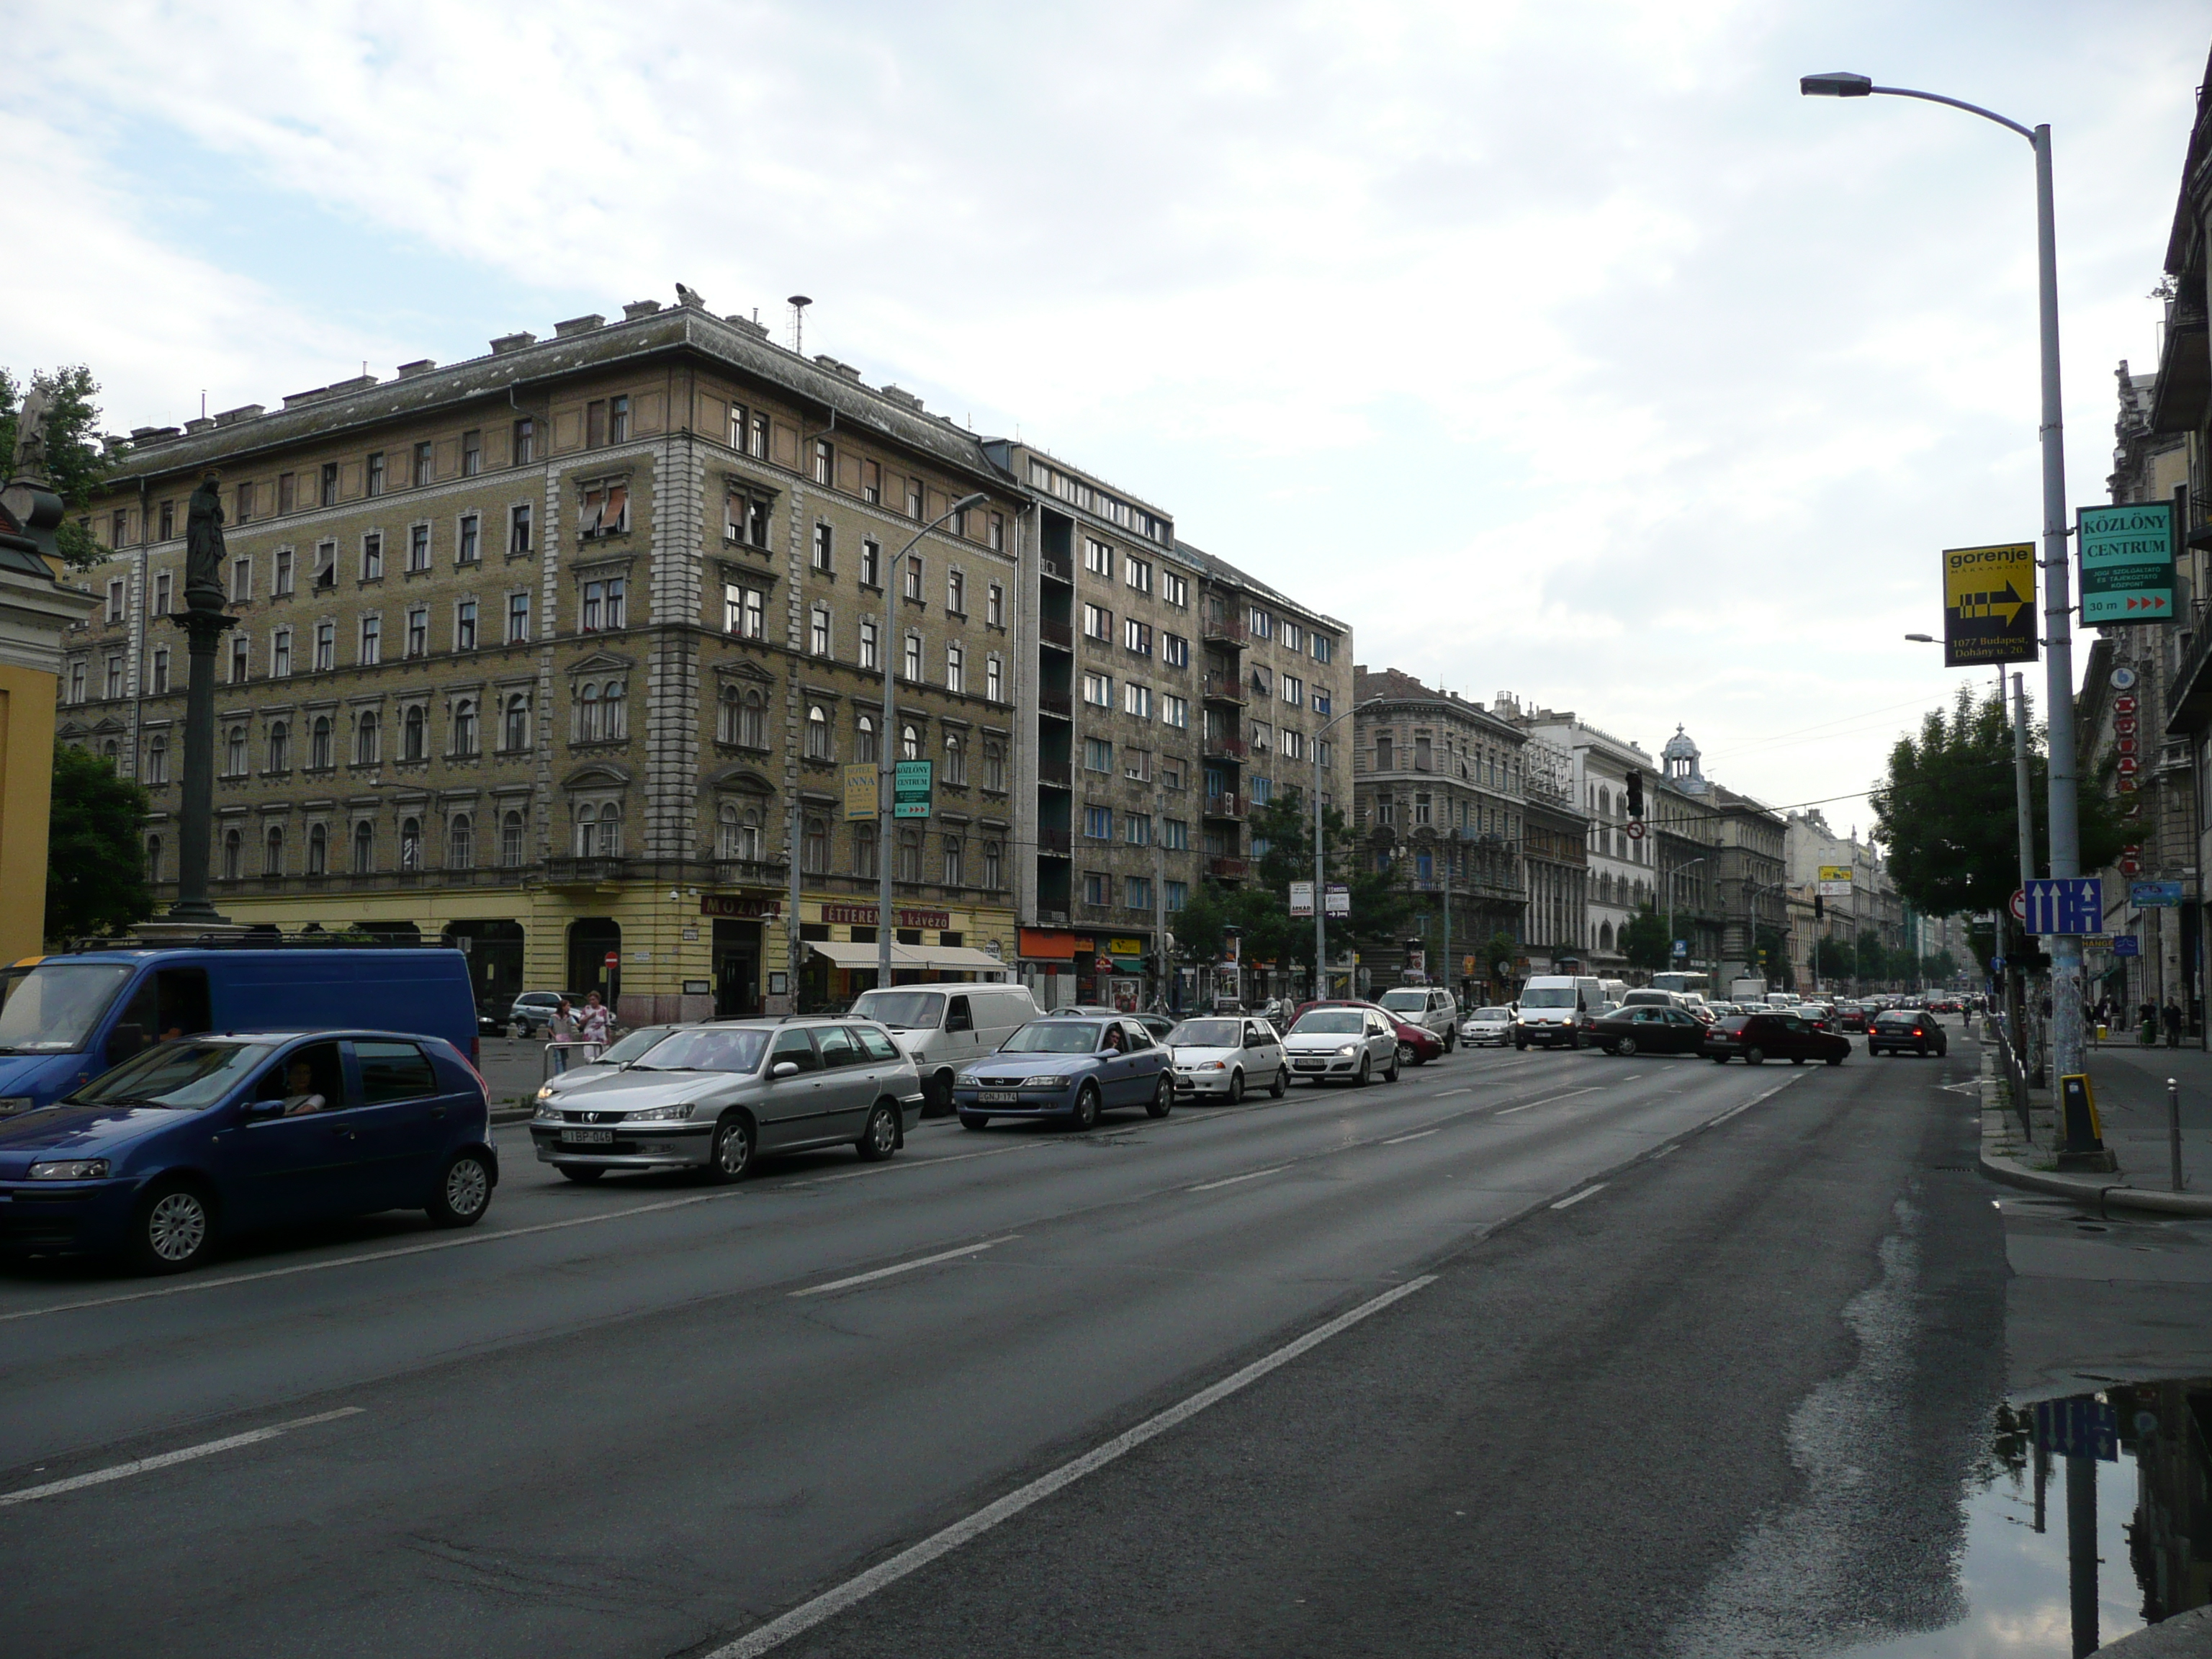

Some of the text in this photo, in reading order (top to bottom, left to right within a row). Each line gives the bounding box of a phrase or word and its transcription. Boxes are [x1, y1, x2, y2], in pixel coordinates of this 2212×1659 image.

[2084, 512, 2167, 534] KÖZLÖNY
[2087, 540, 2165, 558] CENTRUM
[1950, 548, 2028, 569] gorenje
[2090, 602, 2103, 611] 30
[1953, 636, 2029, 647] 1077 Budapest,
[1955, 647, 1994, 658] Dohány
[2010, 646, 2026, 655] 20.
[897, 765, 929, 774] KÖZLÖNY
[846, 776, 876, 787] ANNA
[706, 898, 777, 916] MOZAIK
[907, 912, 948, 928] kávézó
[984, 1092, 1016, 1101] GNJ-174
[570, 1131, 611, 1142] IBP-046
